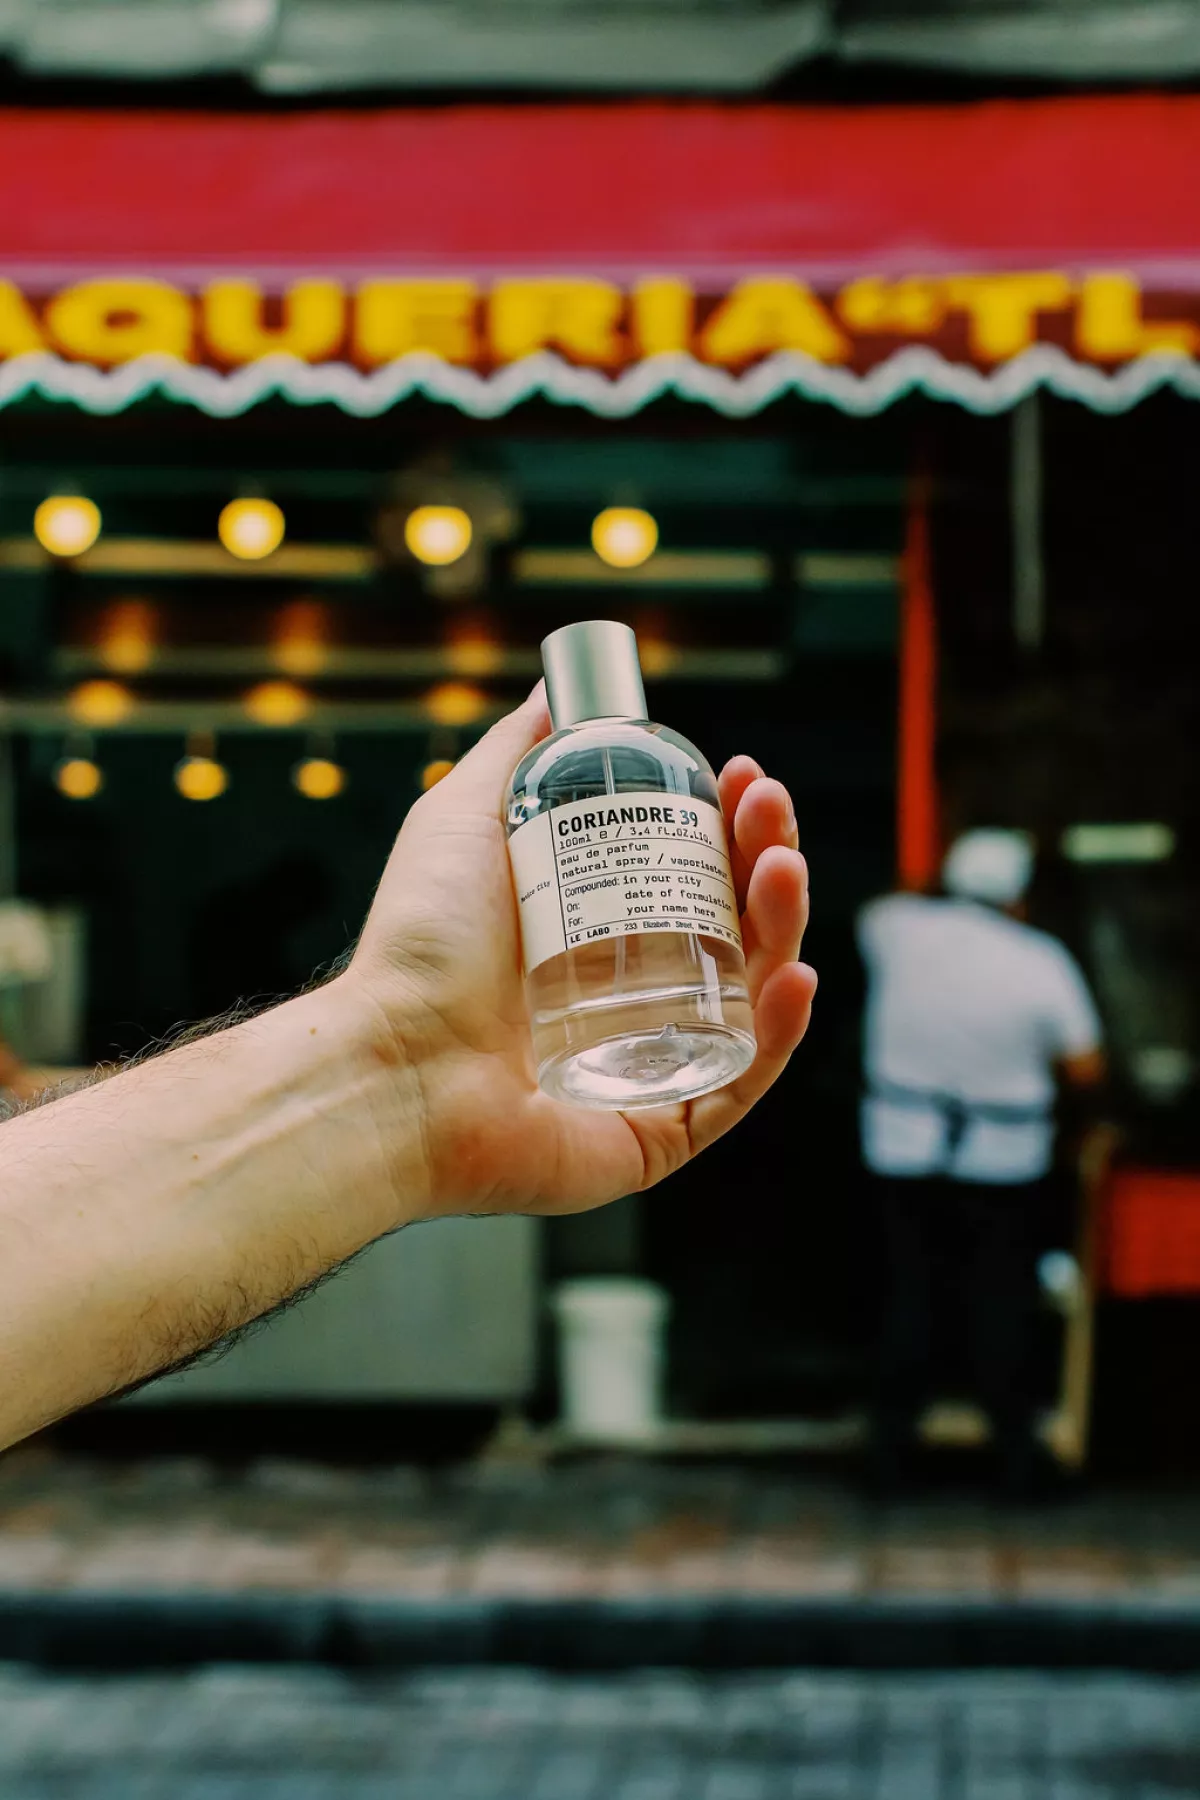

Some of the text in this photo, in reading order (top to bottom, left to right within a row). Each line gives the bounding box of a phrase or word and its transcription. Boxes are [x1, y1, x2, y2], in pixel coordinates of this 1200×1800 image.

[558, 807, 698, 836] CORIANDRE 39
[560, 833, 592, 850] 100ml
[615, 826, 622, 838] /
[630, 826, 650, 836] 3.4
[560, 842, 650, 866] eau de parfum
[562, 860, 609, 880] natural
[615, 856, 650, 869] spray
[657, 853, 664, 865] /
[565, 875, 702, 898] Compounded: in your city
[567, 888, 732, 913] On: date of formulation
[568, 904, 716, 928] For: your name here
[570, 933, 581, 944] LE
[587, 926, 610, 938] LABO
[624, 922, 638, 931] 233
[643, 920, 671, 929] Elizabeth
